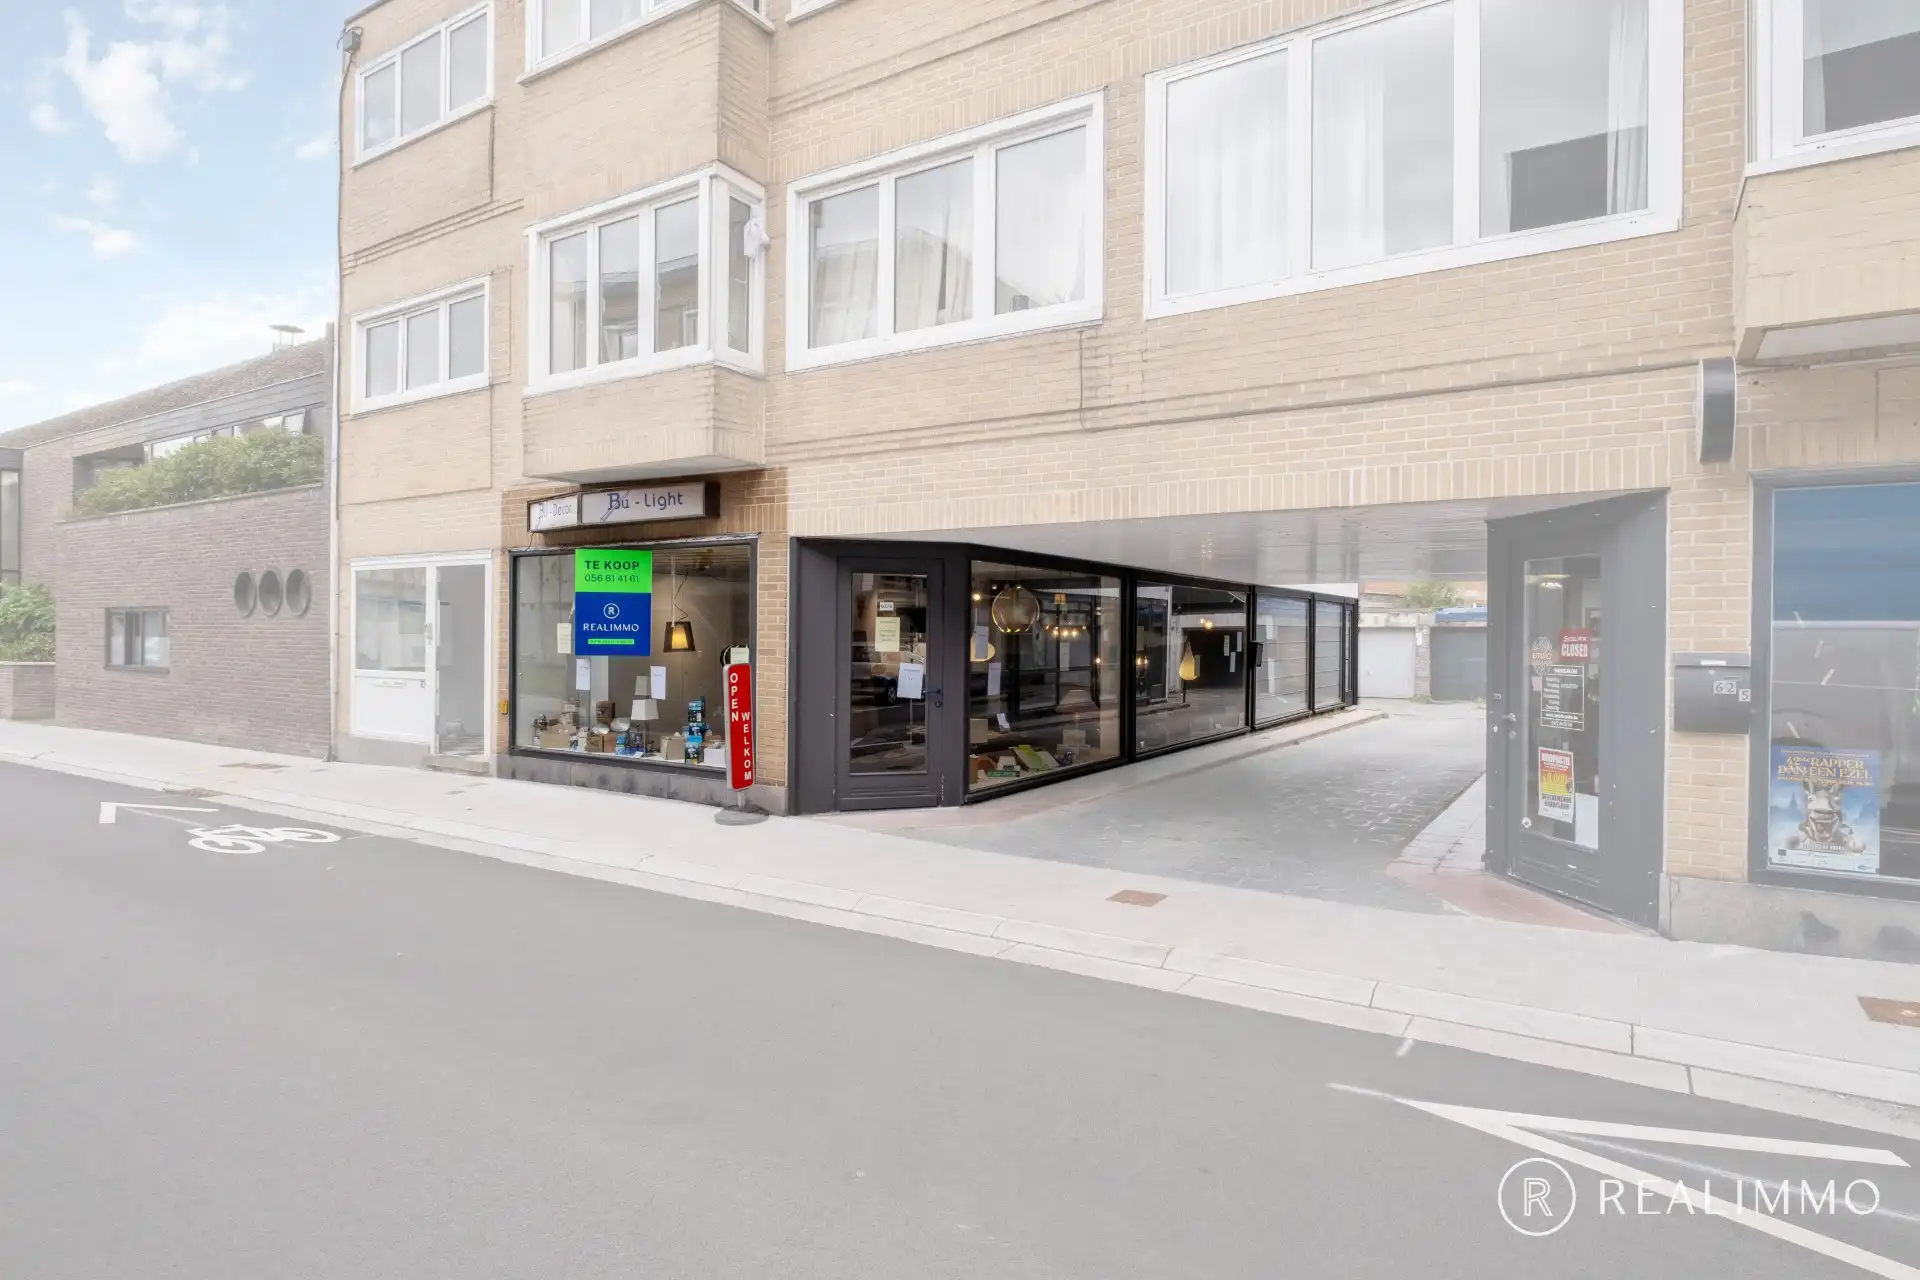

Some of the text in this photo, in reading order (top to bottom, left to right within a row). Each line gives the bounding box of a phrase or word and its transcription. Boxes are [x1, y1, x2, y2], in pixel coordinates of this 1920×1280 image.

[644, 491, 684, 511] Light
[585, 560, 640, 570] TE KOOP
[584, 574, 640, 583] 056 61 41 61
[583, 623, 640, 632] REALIMMO
[1561, 643, 1588, 657] CLOSED
[730, 673, 739, 722] OPEN
[741, 711, 752, 780] WELKOM
